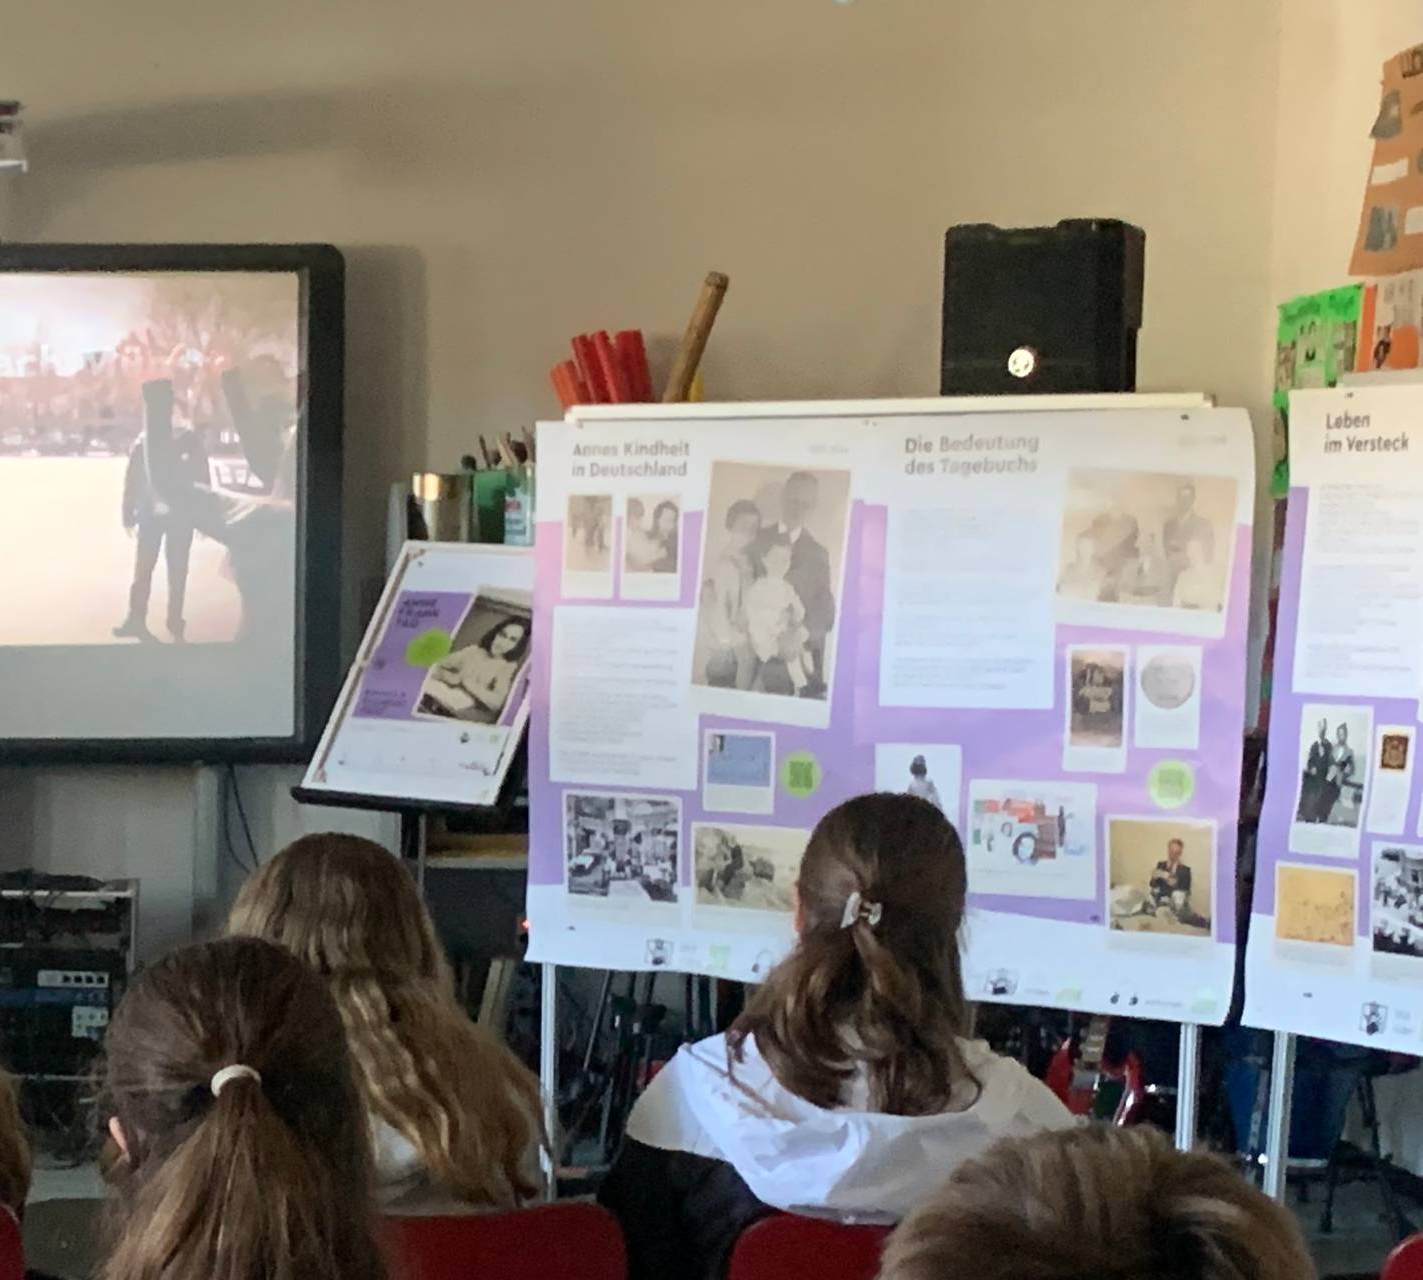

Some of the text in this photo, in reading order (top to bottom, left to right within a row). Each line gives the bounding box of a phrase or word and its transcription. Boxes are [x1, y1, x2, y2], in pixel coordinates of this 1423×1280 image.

[1325, 409, 1371, 430] Leben
[573, 439, 690, 456] Annes Kindheit
[904, 433, 1040, 453] Die Bedeutung
[1324, 432, 1409, 453] im Versteck
[571, 460, 687, 477] in Deutschland
[904, 455, 1037, 478] des Tagebuchs
